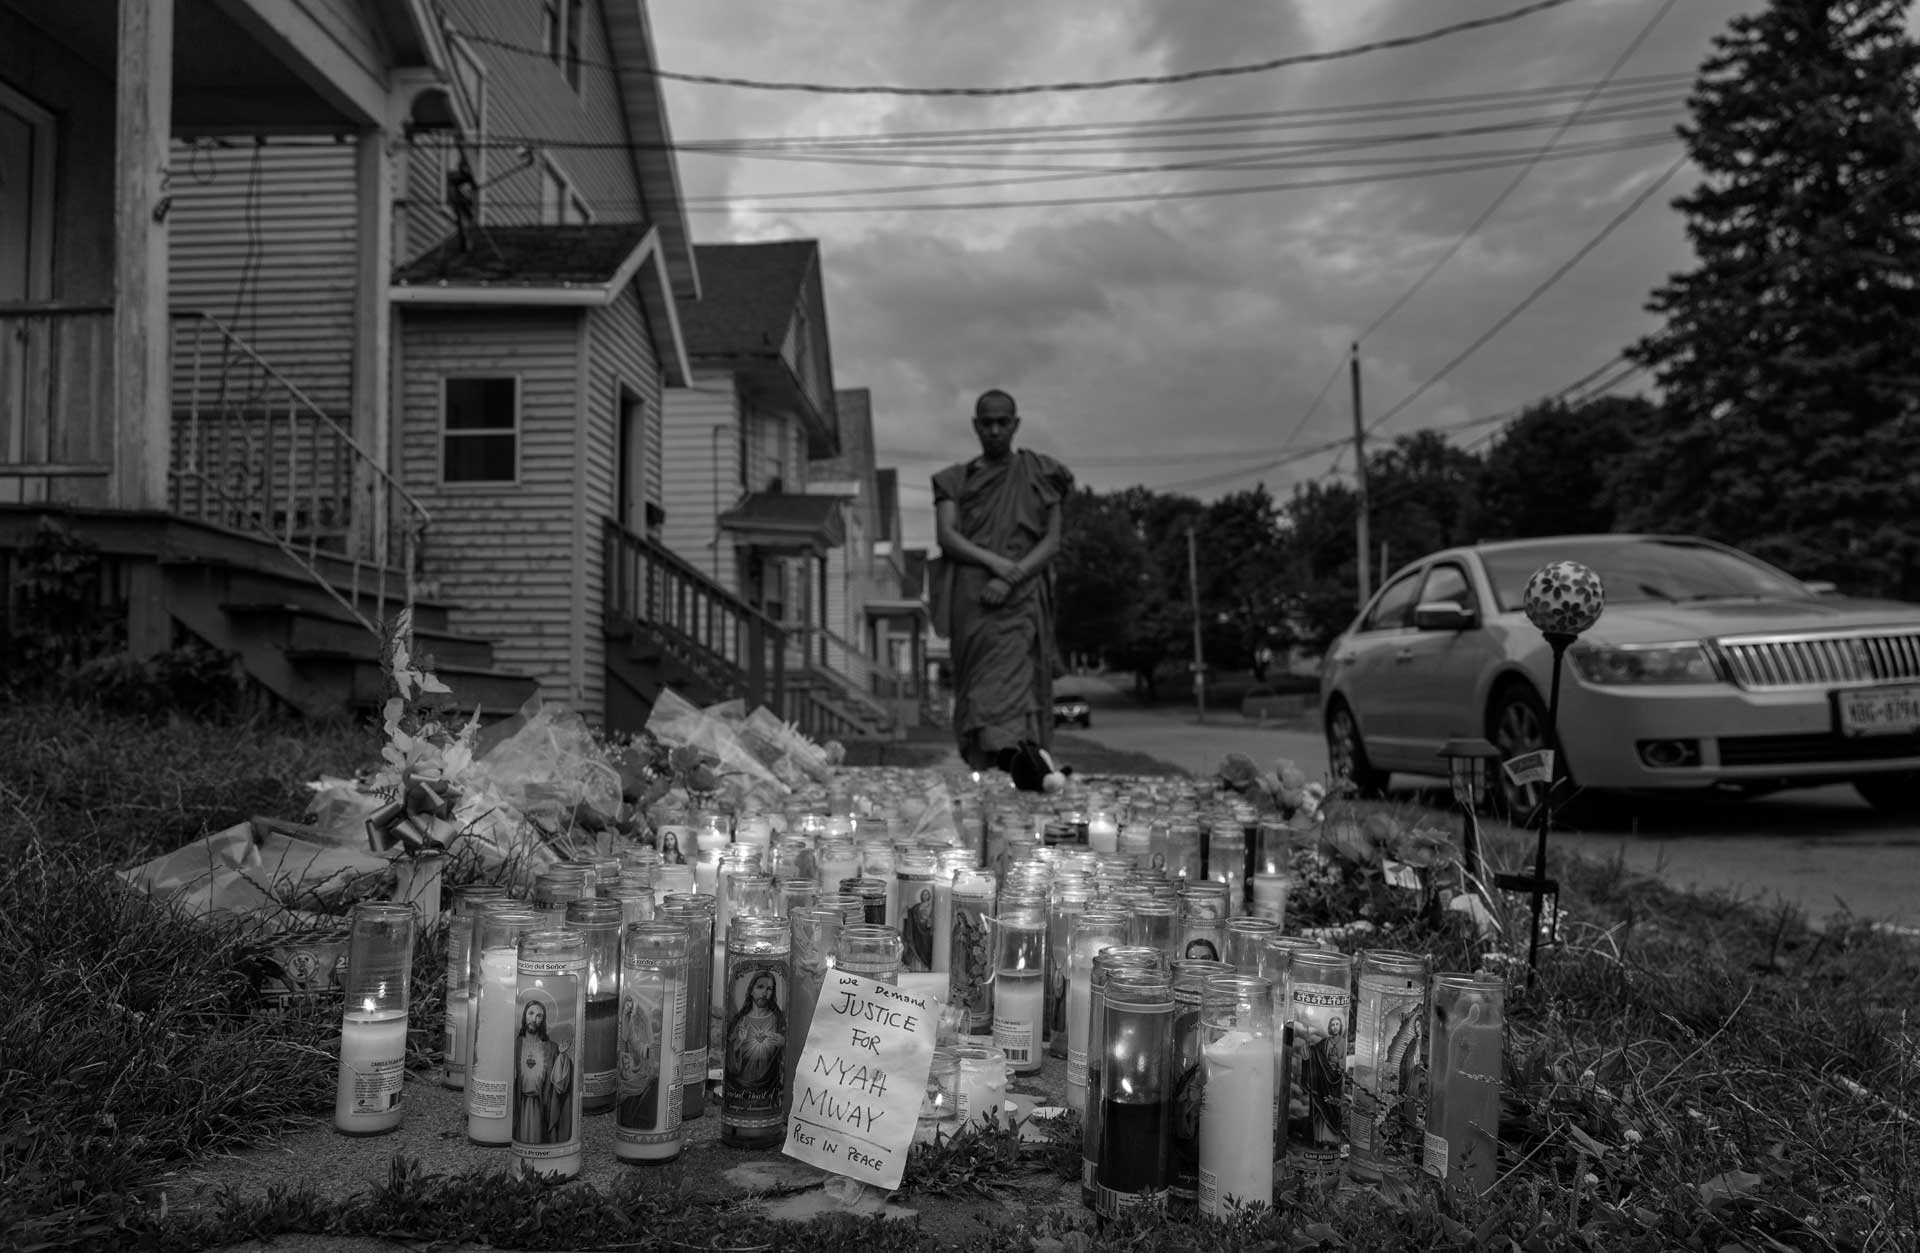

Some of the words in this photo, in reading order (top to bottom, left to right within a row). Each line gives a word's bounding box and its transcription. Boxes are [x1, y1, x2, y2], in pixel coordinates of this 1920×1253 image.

[831, 991, 919, 1032] JUSTICE
[875, 985, 926, 1010] Demand
[852, 1028, 881, 1056] FOR
[814, 1055, 888, 1098] NYAH
[799, 1087, 885, 1133] MWAY
[823, 1140, 839, 1154] IN
[848, 1147, 884, 1172] PEACE
